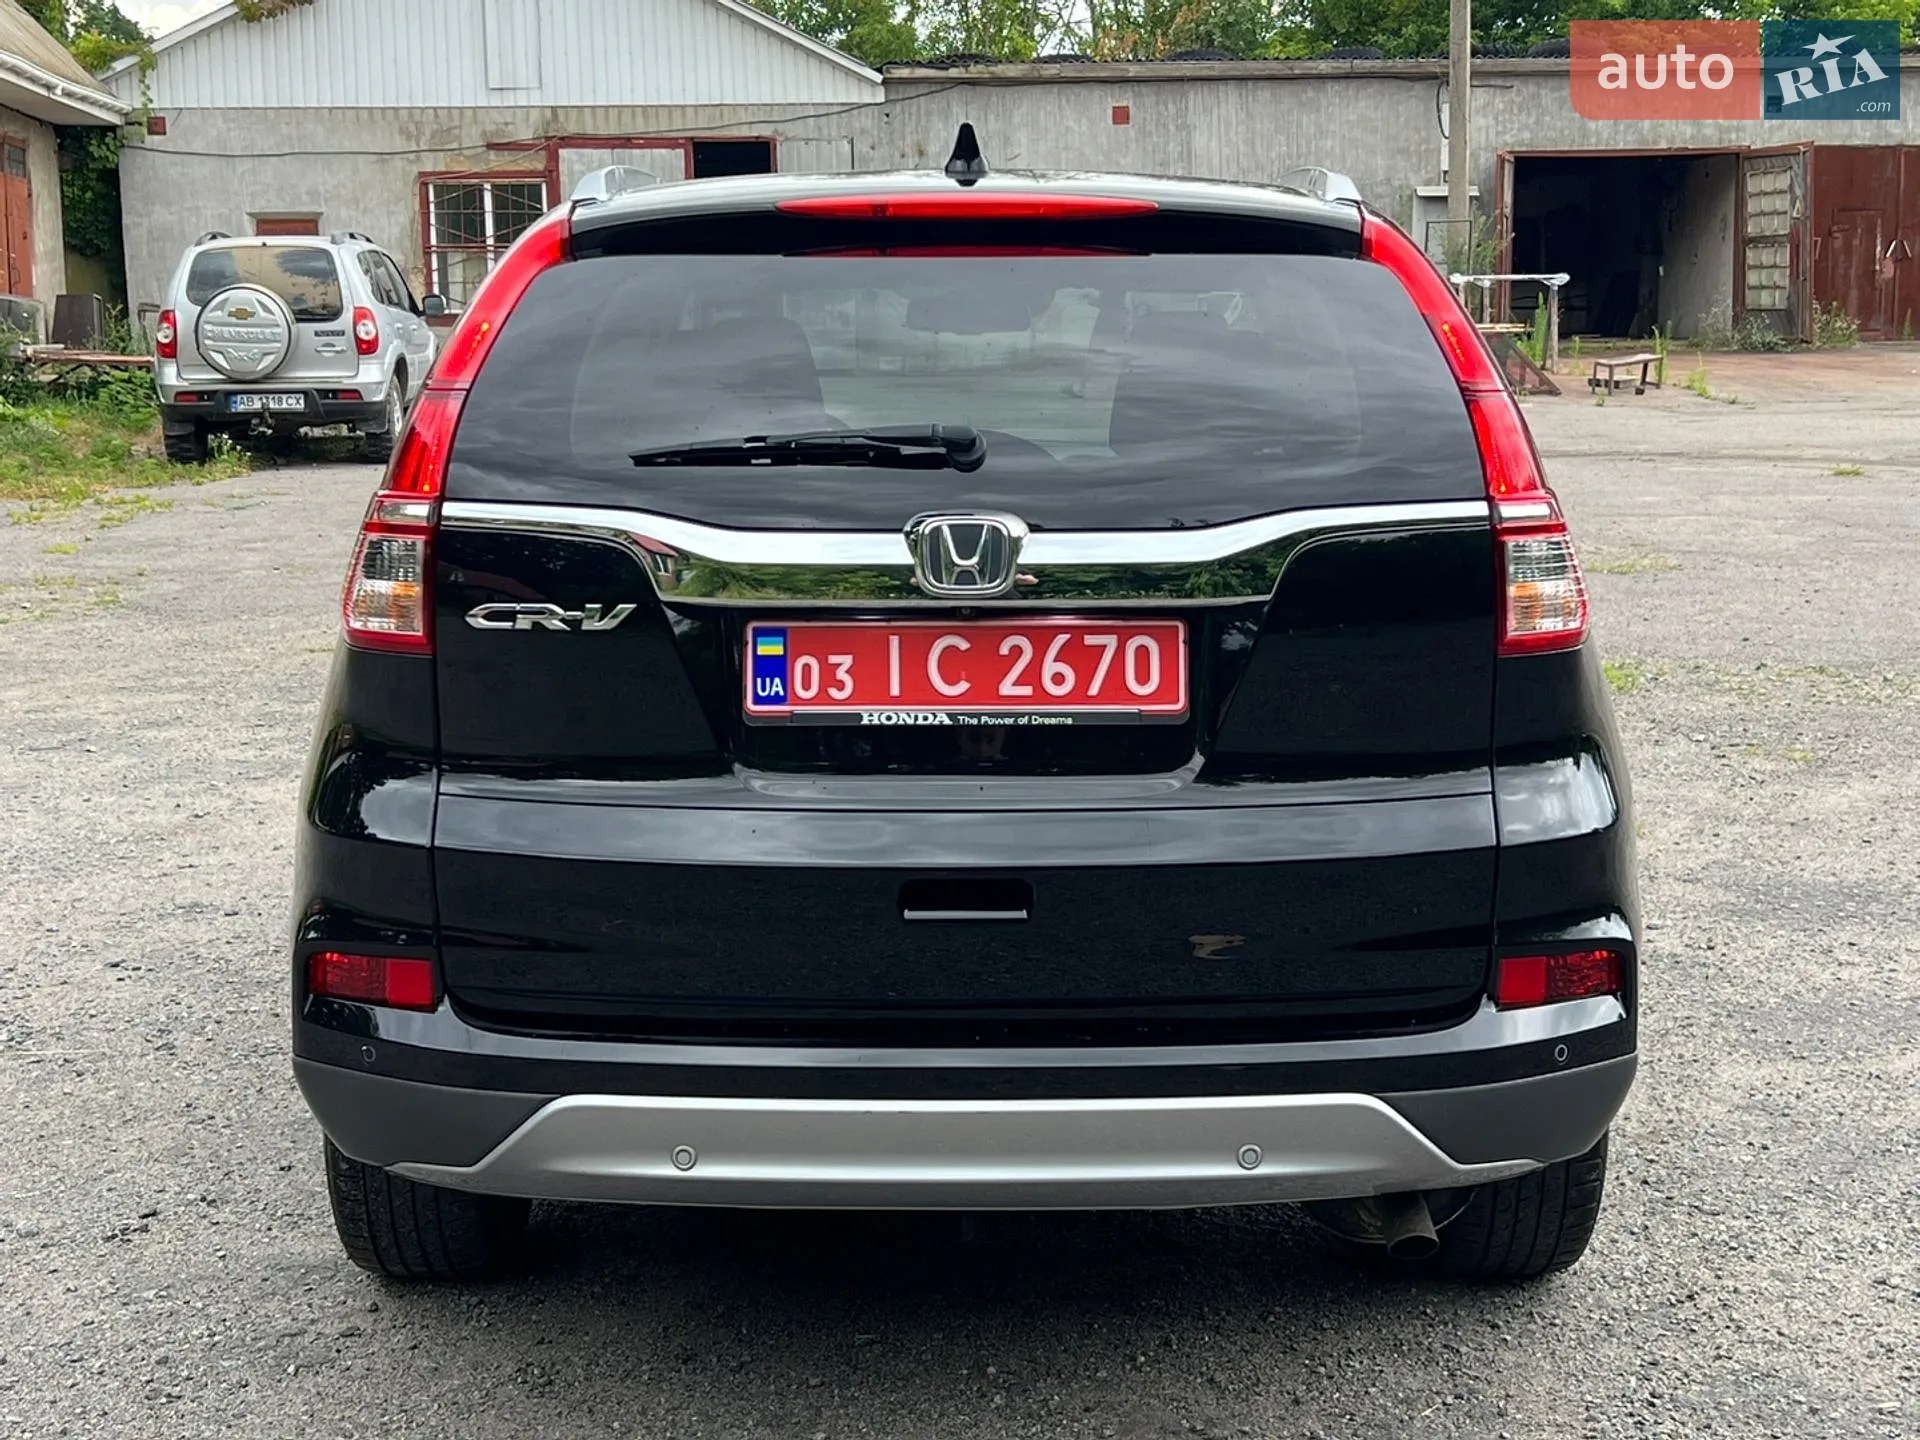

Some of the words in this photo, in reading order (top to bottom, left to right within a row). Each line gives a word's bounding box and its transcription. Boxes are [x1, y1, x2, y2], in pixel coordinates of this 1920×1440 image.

[239, 395, 255, 408] AB
[285, 395, 303, 408] CX
[464, 602, 638, 631] CR-V
[793, 654, 854, 701] 03
[998, 633, 1161, 697] 2670
[756, 677, 785, 697] UA
[860, 711, 953, 725] HONDA
[957, 715, 977, 725] The
[980, 715, 1014, 725] Power
[1017, 714, 1028, 725] of
[1031, 715, 1073, 725] Dreams
